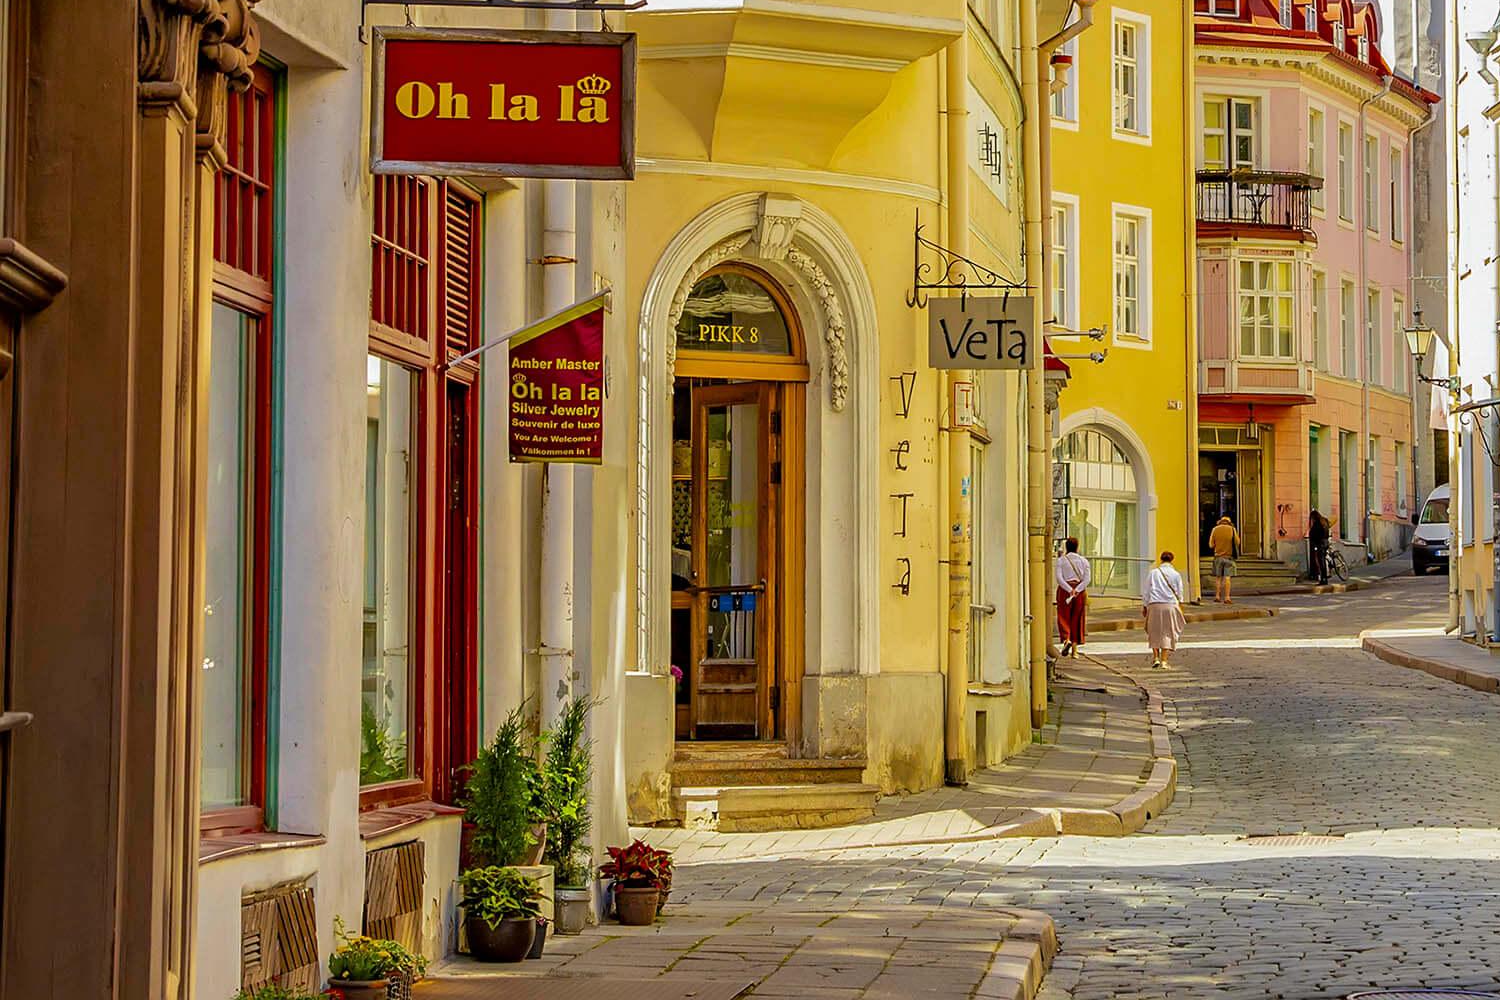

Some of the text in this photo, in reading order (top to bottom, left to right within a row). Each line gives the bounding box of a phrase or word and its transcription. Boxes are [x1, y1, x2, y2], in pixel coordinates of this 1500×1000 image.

[395, 81, 471, 119] Oh
[487, 83, 540, 122] la
[699, 324, 759, 344] PIKK 8
[938, 318, 1027, 365] VeTa
[511, 357, 600, 371] Amber Master
[511, 382, 600, 401] Oh la la
[511, 401, 600, 418] Silver Jewelry
[511, 417, 601, 429] Souvenir de luxe
[514, 432, 530, 441] You
[532, 434, 549, 443] Are
[550, 435, 592, 443] Welcome
[576, 447, 585, 455] in
